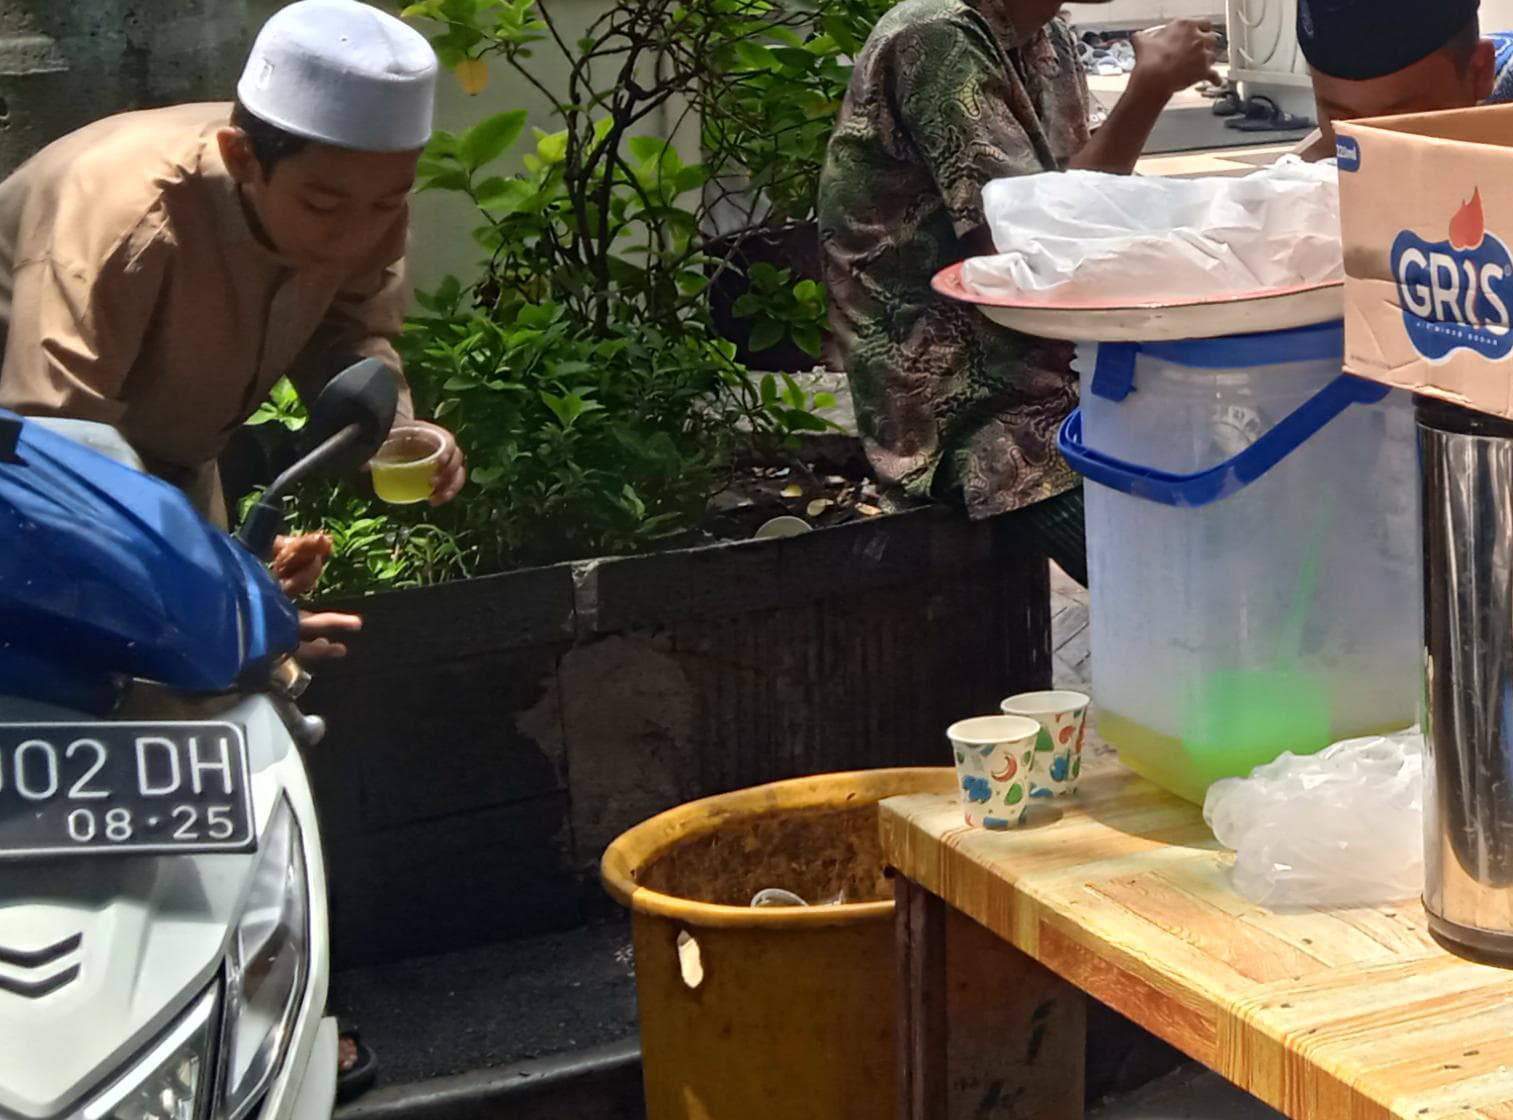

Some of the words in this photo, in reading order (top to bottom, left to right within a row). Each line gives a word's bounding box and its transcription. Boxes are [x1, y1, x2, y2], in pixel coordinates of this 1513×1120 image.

[1398, 246, 1510, 336] GRIS
[0, 738, 110, 800] 02
[135, 736, 233, 796] DH
